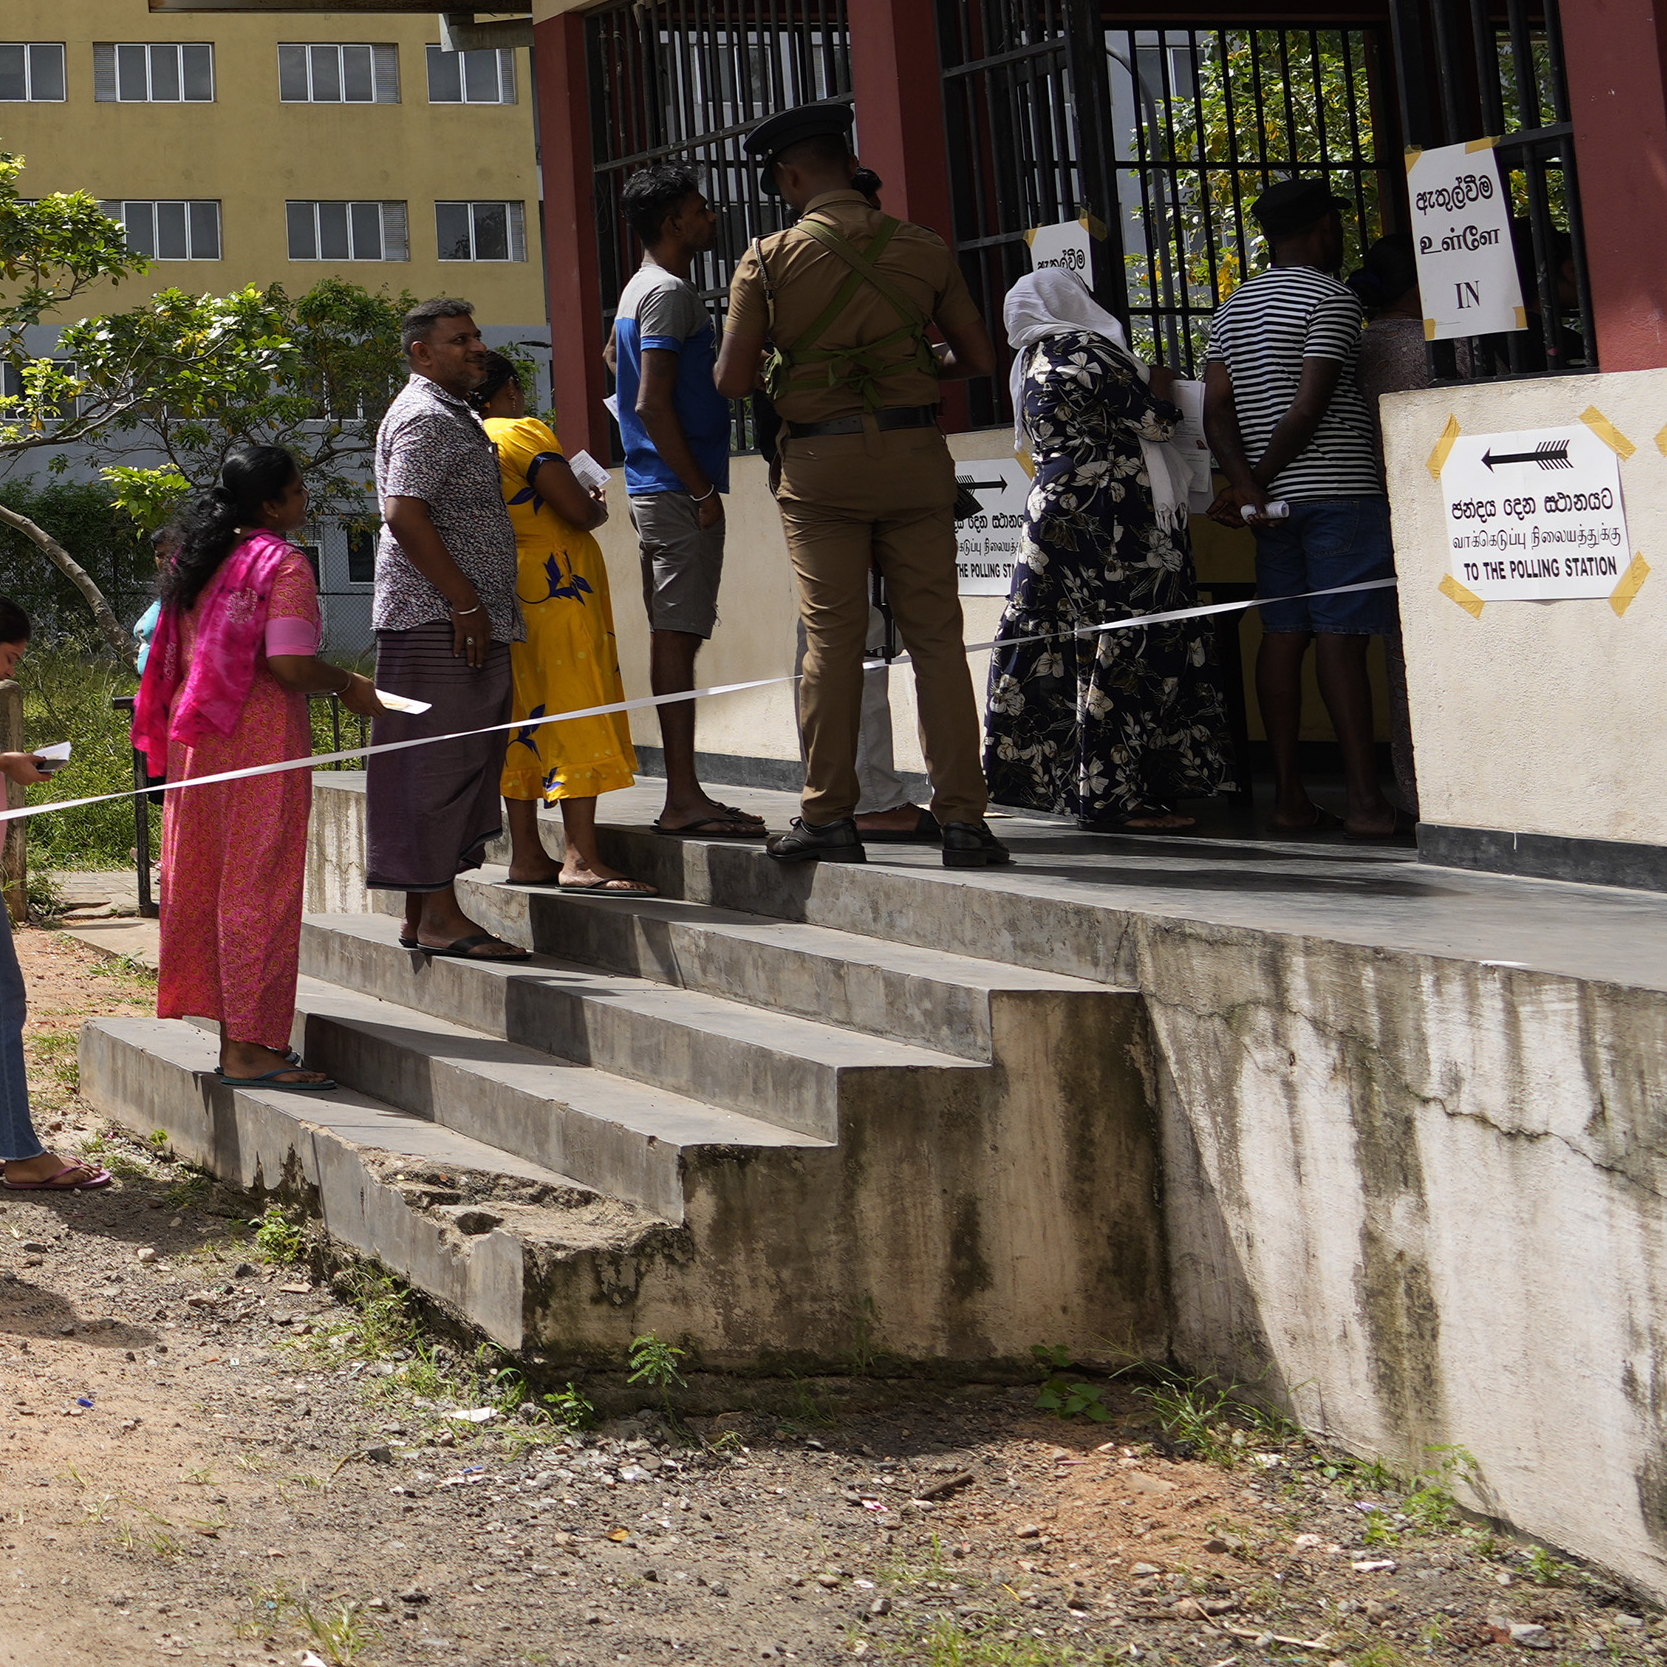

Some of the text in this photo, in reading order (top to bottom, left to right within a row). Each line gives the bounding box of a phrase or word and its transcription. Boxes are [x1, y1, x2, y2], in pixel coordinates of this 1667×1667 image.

[1415, 174, 1494, 216] ඇතුල්වීම
[1419, 225, 1501, 255] உள்ளே
[1453, 280, 1481, 310] IN
[1451, 497, 1497, 524] ඡන්දය
[1503, 496, 1536, 521] දෙන
[971, 563, 1001, 578] POLLING
[1463, 555, 1618, 581] TO THE POLLING STATION
